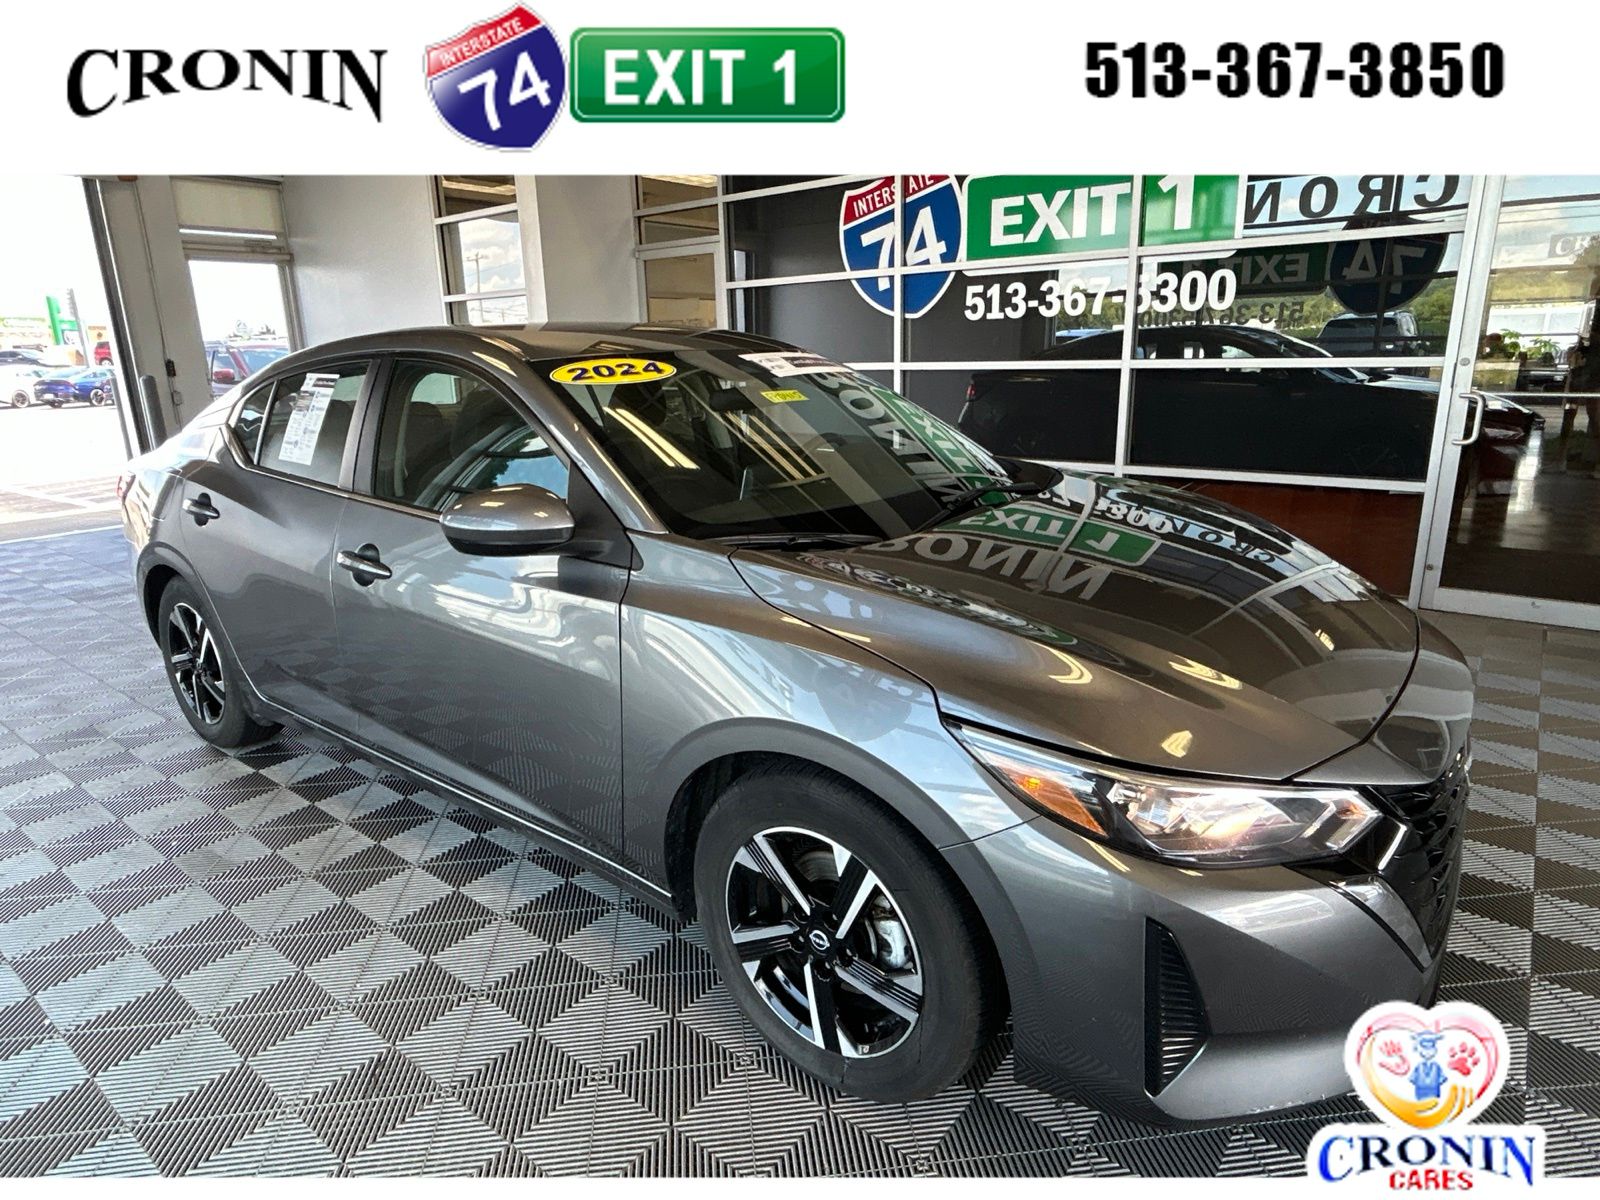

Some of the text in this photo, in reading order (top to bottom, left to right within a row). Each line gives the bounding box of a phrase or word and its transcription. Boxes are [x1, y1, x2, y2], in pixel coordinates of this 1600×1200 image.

[853, 175, 934, 218] INTERSATE
[990, 174, 1196, 247] EXIT 1
[860, 205, 947, 292] 74
[567, 361, 664, 381] 2024
